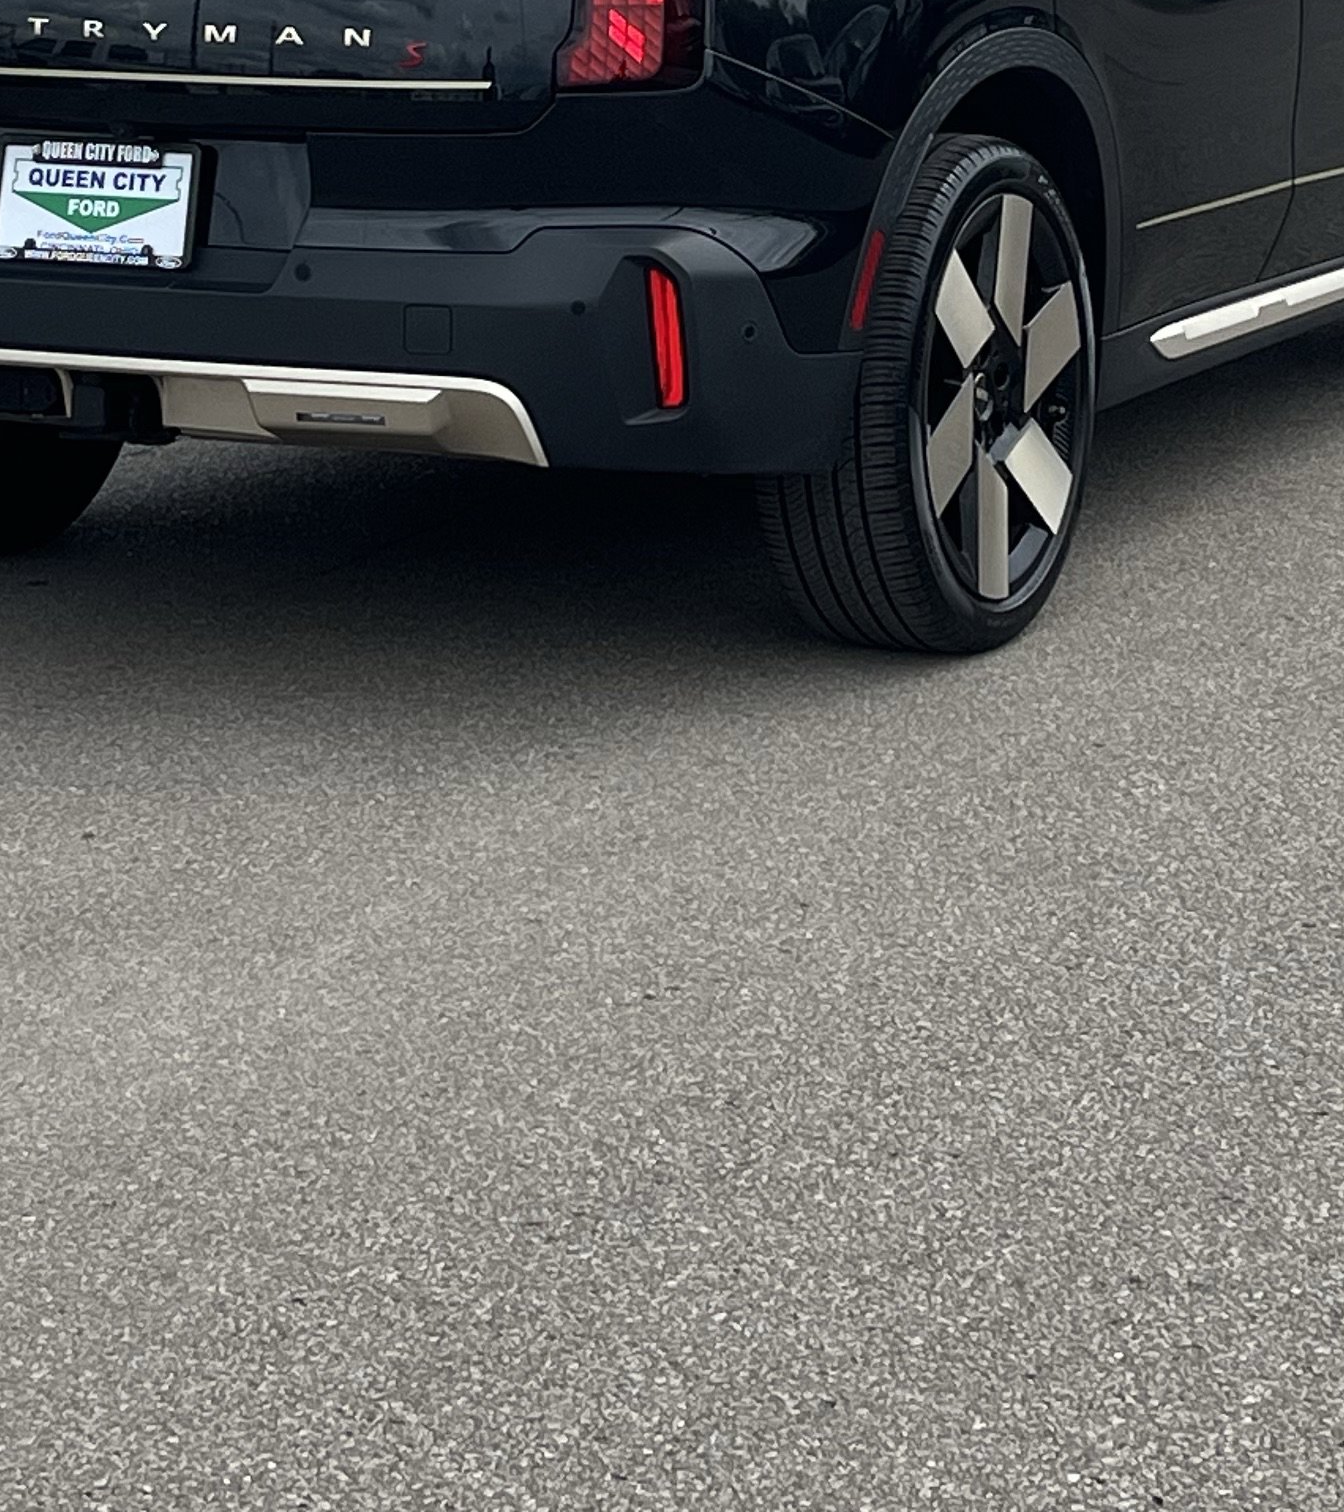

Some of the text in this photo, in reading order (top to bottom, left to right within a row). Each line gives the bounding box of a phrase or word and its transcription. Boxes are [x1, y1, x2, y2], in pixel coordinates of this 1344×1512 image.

[400, 42, 426, 69] S
[41, 140, 151, 164] QUEEN CITY FORD
[29, 168, 167, 192] QUEEN CITY
[67, 198, 120, 218] FORD
